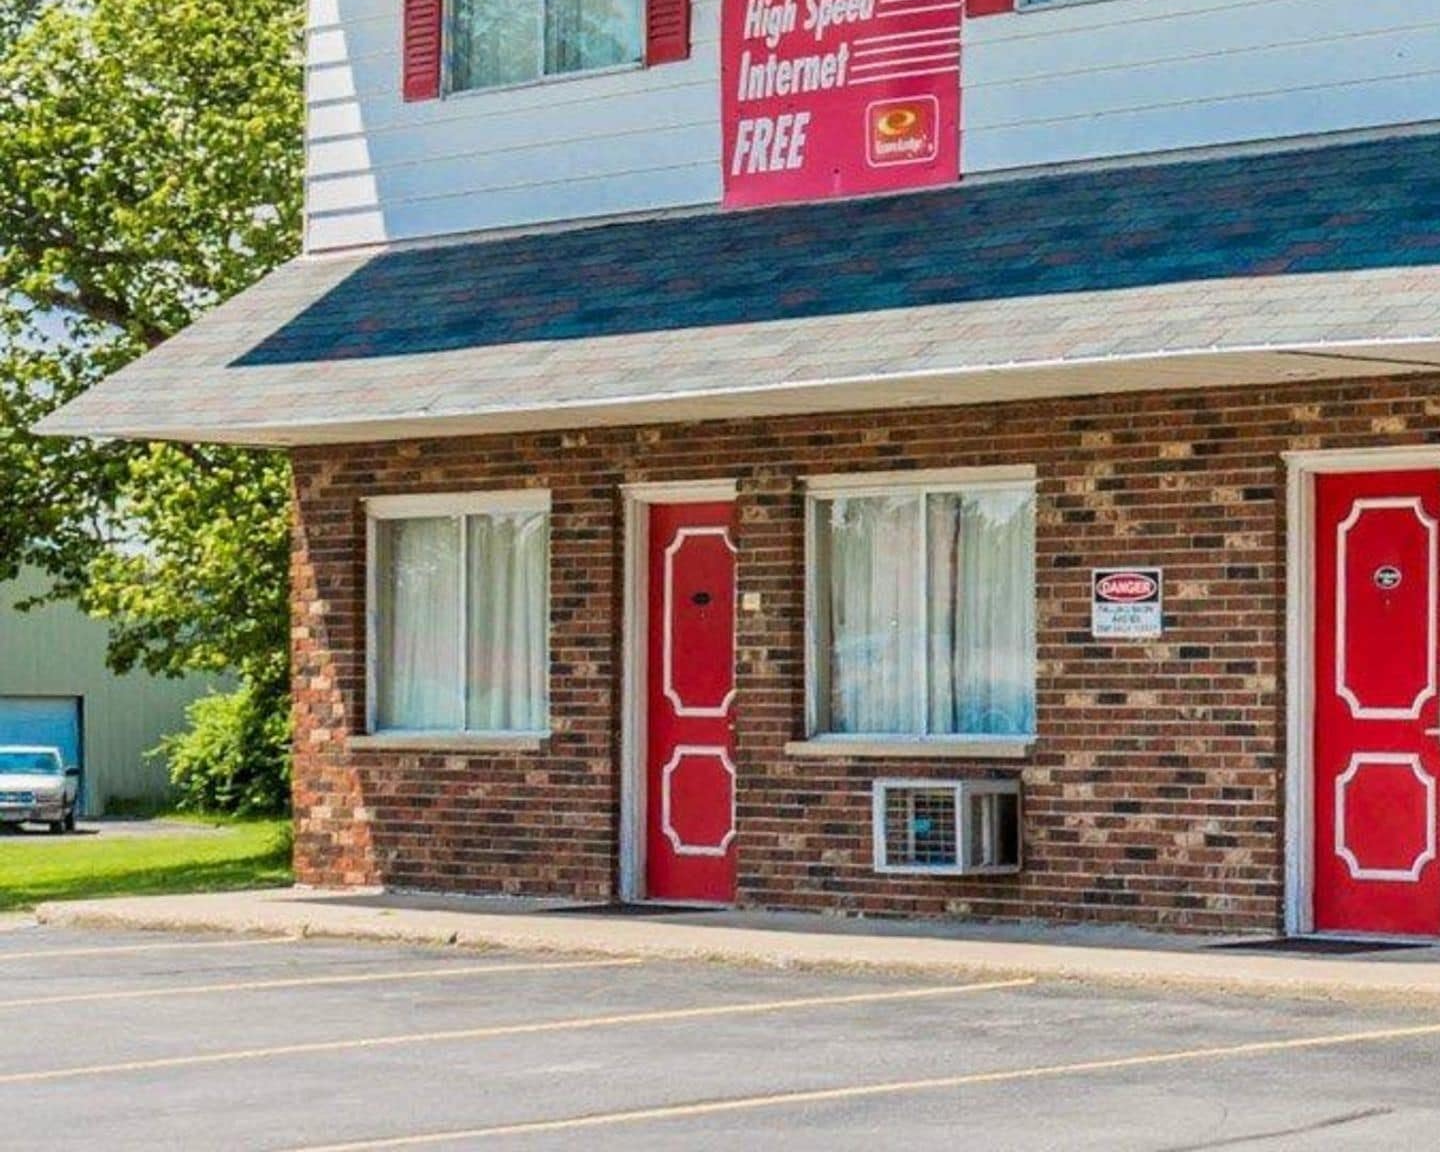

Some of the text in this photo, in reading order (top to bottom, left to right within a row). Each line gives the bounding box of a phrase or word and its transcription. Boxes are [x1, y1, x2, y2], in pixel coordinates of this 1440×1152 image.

[738, 43, 849, 101] Internet
[731, 112, 811, 176] FREE
[1102, 579, 1151, 595] DANGER
